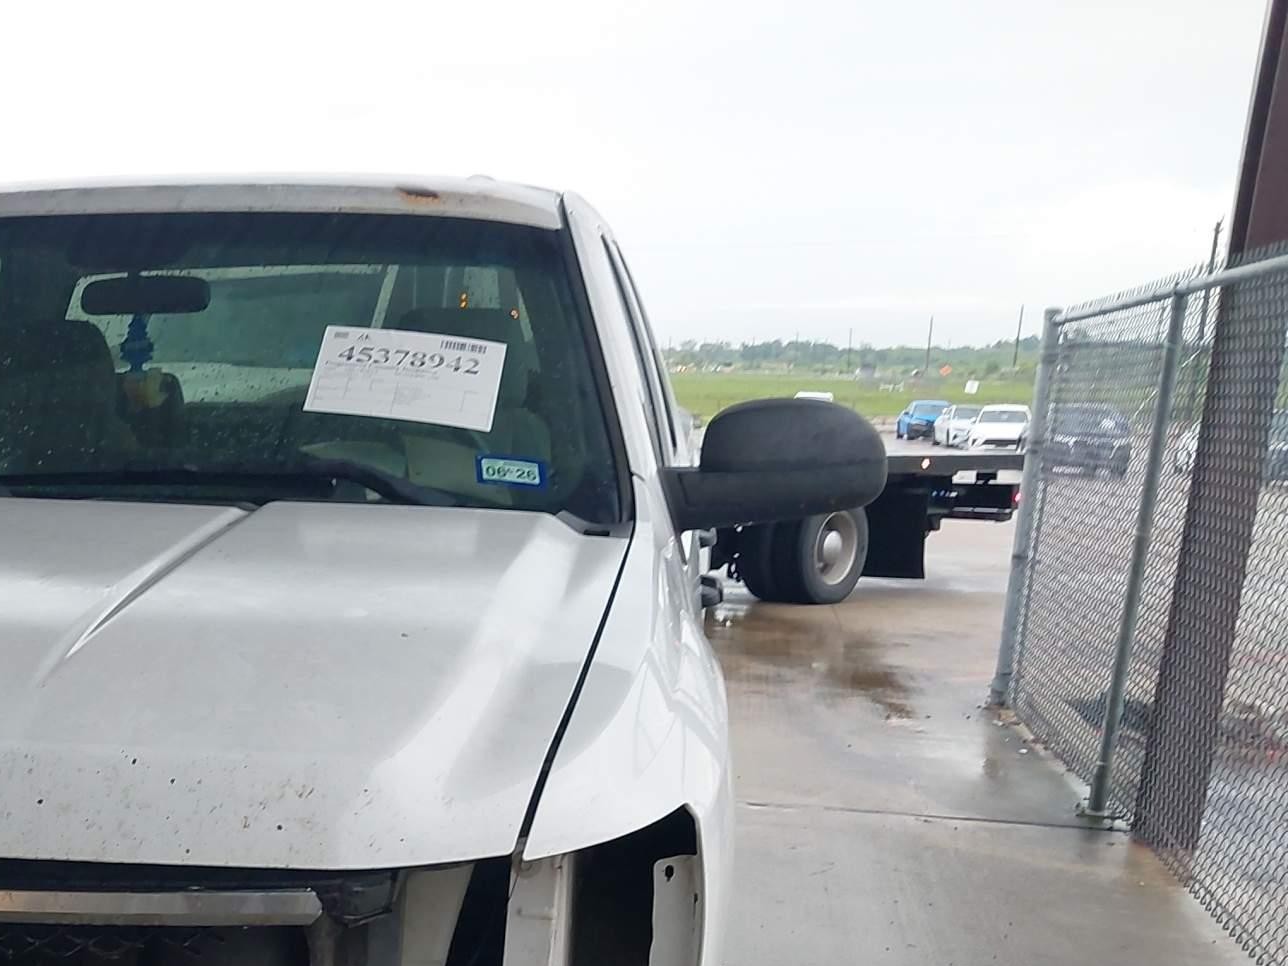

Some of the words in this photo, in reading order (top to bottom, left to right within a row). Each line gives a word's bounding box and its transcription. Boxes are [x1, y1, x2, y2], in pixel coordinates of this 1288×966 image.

[338, 345, 481, 375] 45378942
[486, 465, 507, 478] 06
[515, 468, 537, 481] 26
